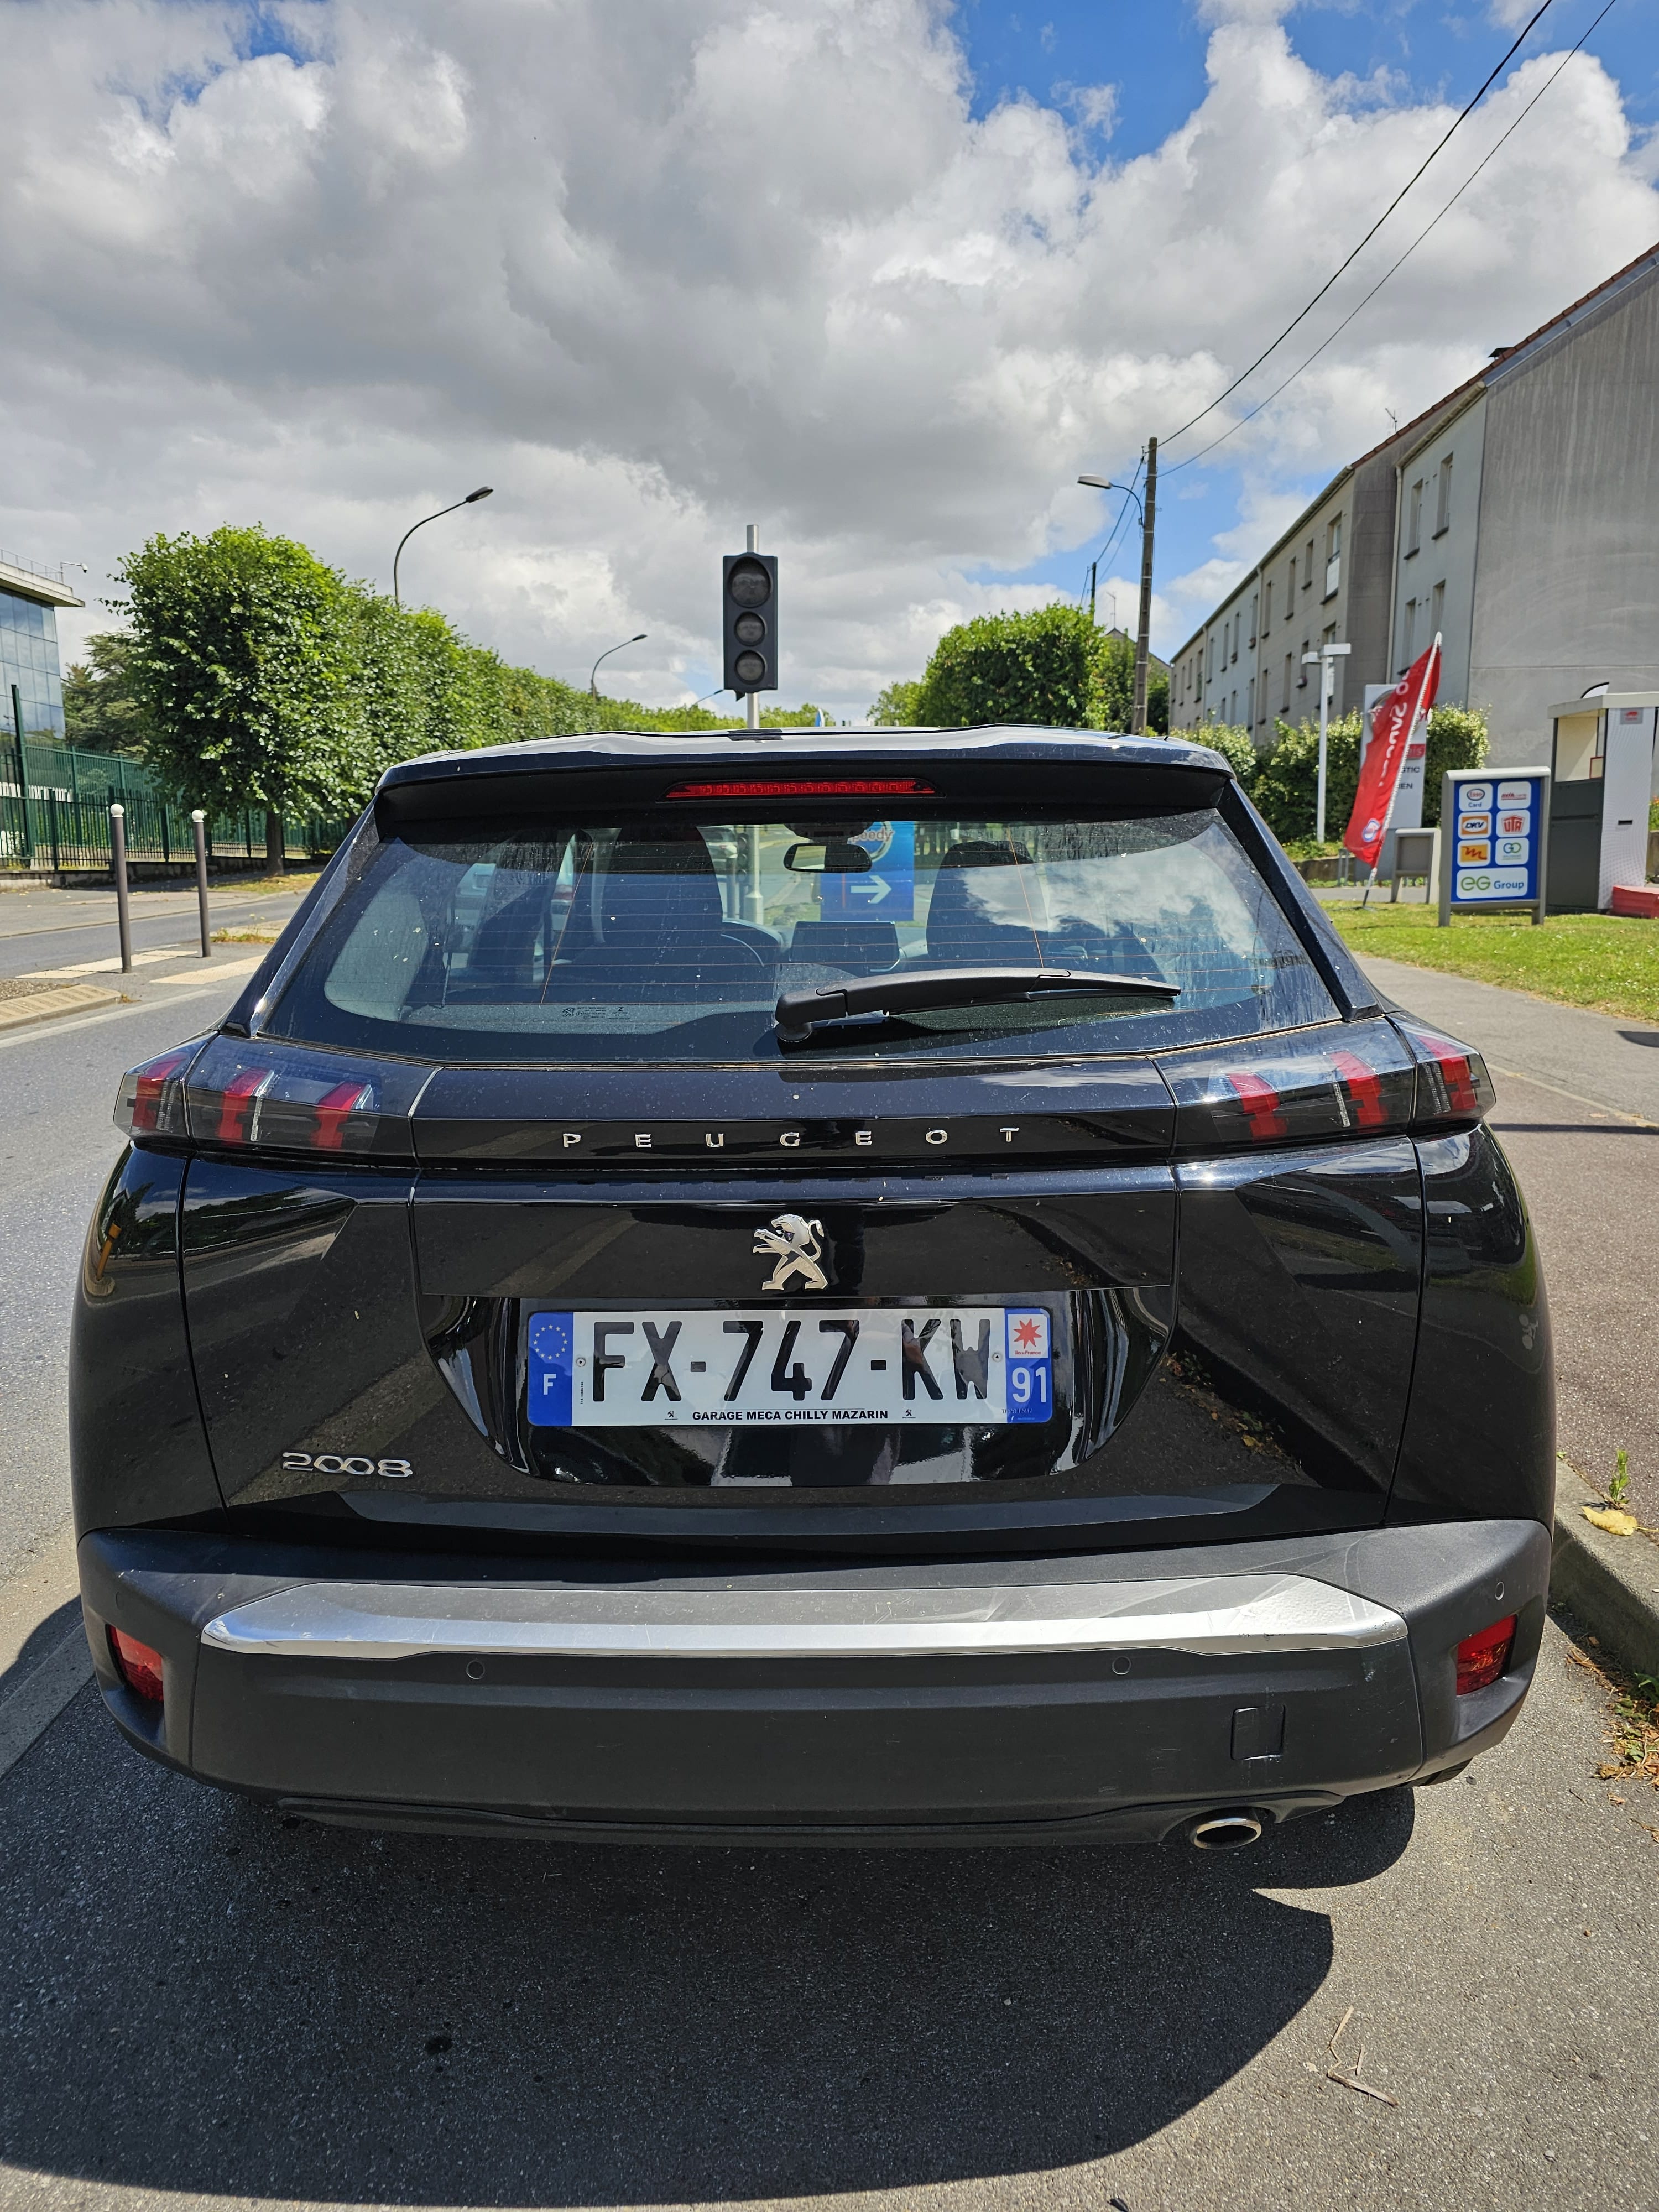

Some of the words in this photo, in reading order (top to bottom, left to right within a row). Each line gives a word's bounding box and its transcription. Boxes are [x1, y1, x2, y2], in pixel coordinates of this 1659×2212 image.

[1503, 816, 1523, 832] UTA
[849, 828, 895, 842] peedy
[1494, 880, 1524, 890] Group
[562, 1127, 1020, 1148] PEUGEOT
[592, 1319, 991, 1402] FX-747-KW
[543, 1374, 557, 1395] F
[1011, 1366, 1047, 1404] 91
[692, 1411, 743, 1421] GARAGE
[747, 1411, 781, 1420] MECA
[785, 1411, 828, 1420] CHILLY
[832, 1410, 888, 1420] MAZARIN
[282, 1452, 413, 1478] 2008
